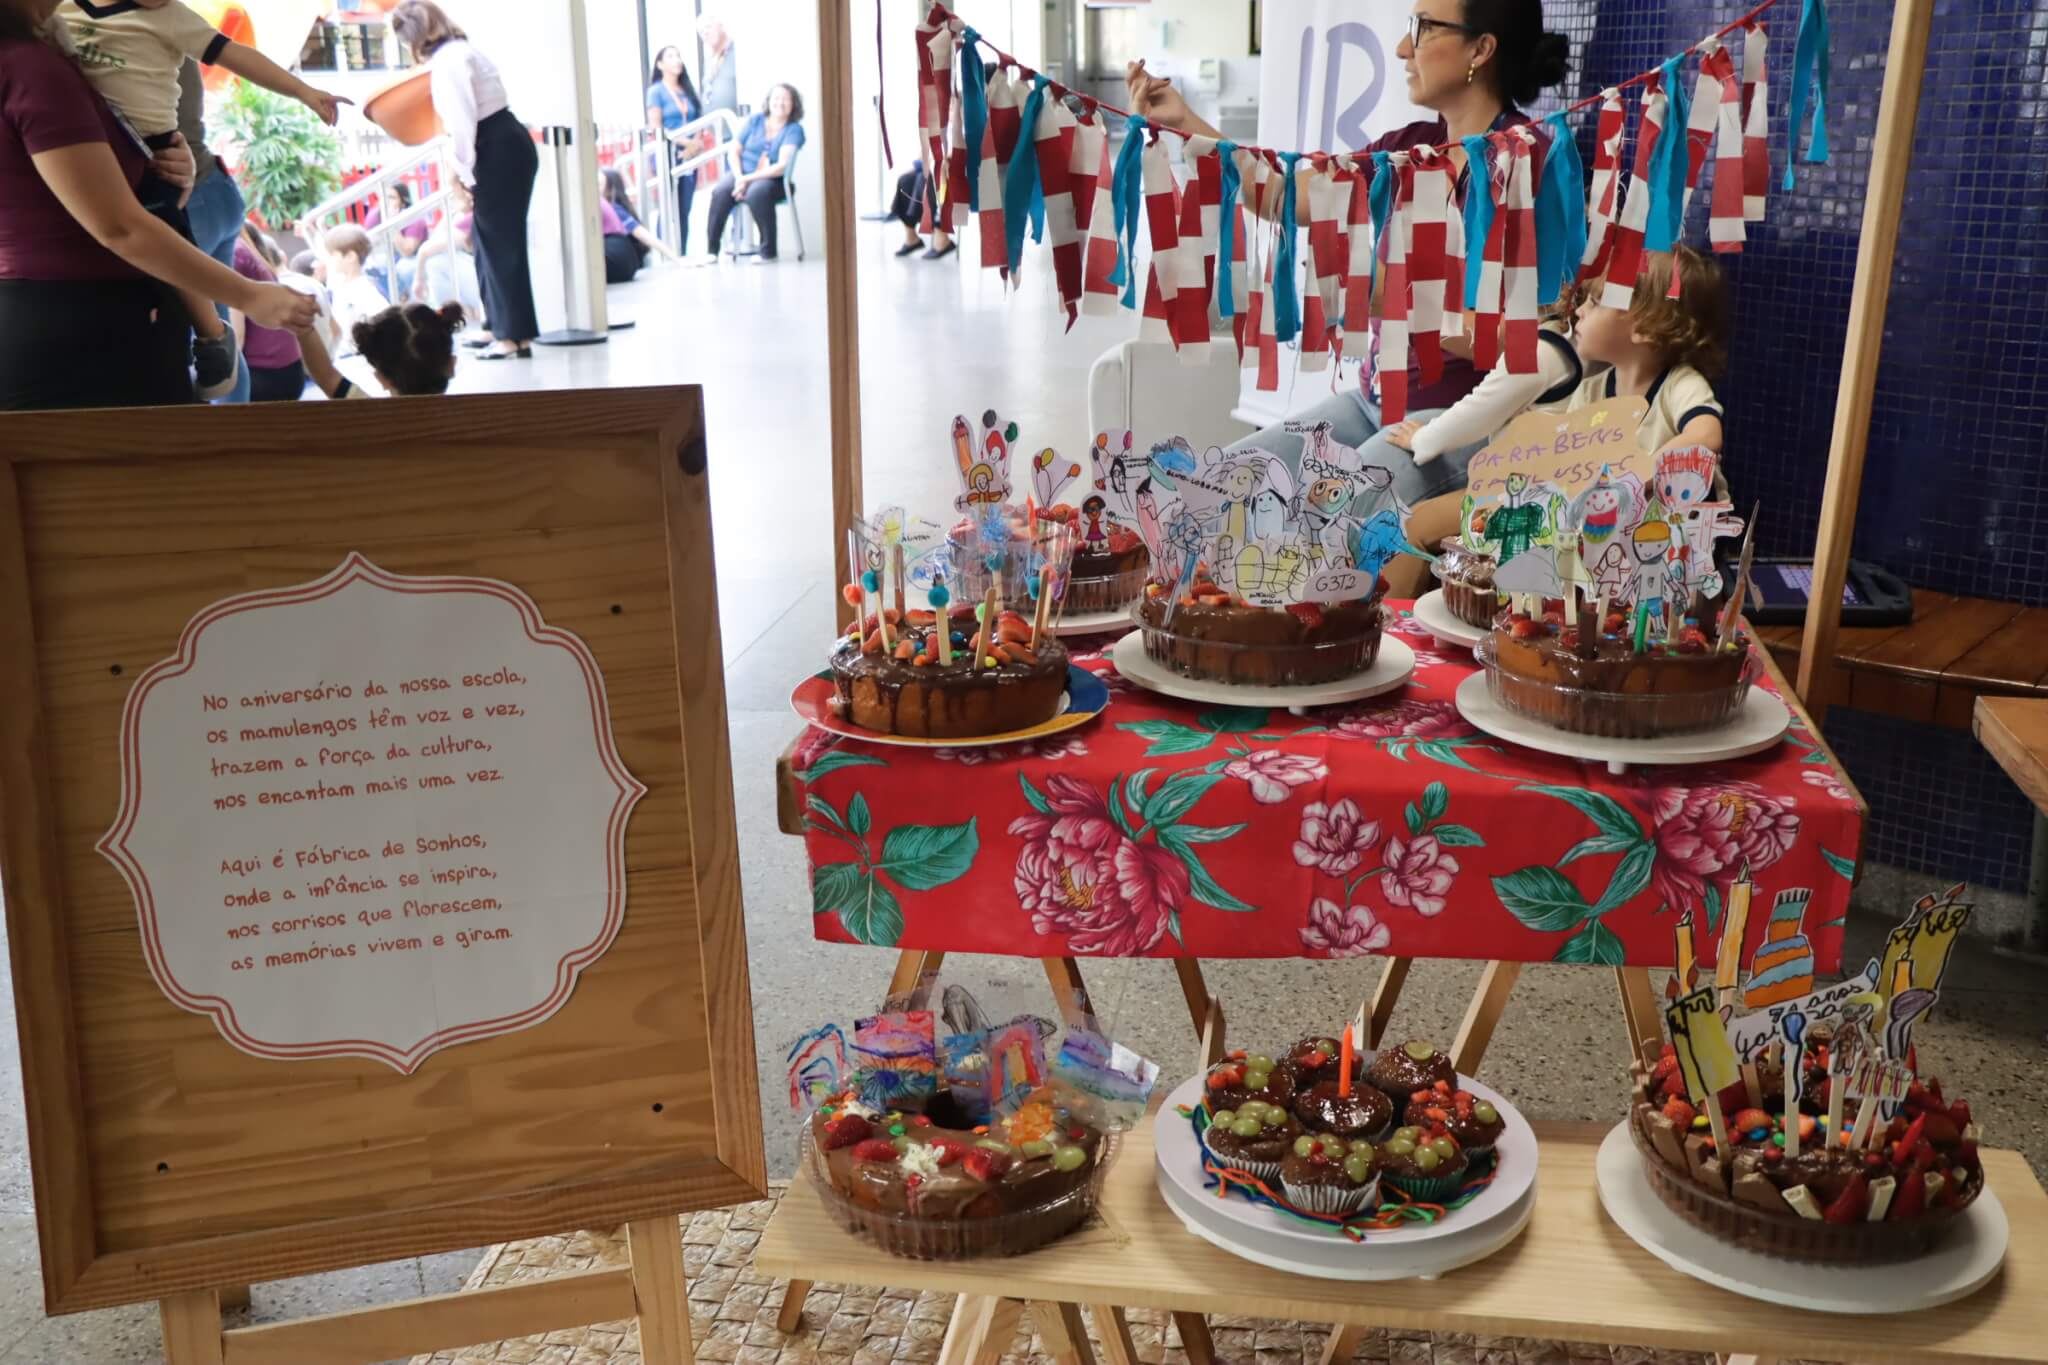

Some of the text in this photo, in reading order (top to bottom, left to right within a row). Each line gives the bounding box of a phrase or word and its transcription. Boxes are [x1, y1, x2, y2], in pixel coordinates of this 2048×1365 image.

[1315, 575, 1357, 592] G3T2
[203, 666, 527, 712] No aniversário da nossa escola,
[206, 704, 525, 744] os mamulengos têm voz e vez,
[210, 735, 492, 777] trazem a força da cultura,
[213, 794, 247, 810] nos
[258, 780, 355, 804] encantam
[366, 776, 408, 794] mais
[418, 776, 456, 789] uma
[221, 833, 487, 877] Aqui é Fábrica de Sonhos,
[224, 865, 497, 907] onde a infância se inspira,
[227, 898, 502, 939] nos sorrisos que florescem,
[231, 928, 513, 971] as memórias vivem e giram.
[1806, 984, 1864, 1009] anos
